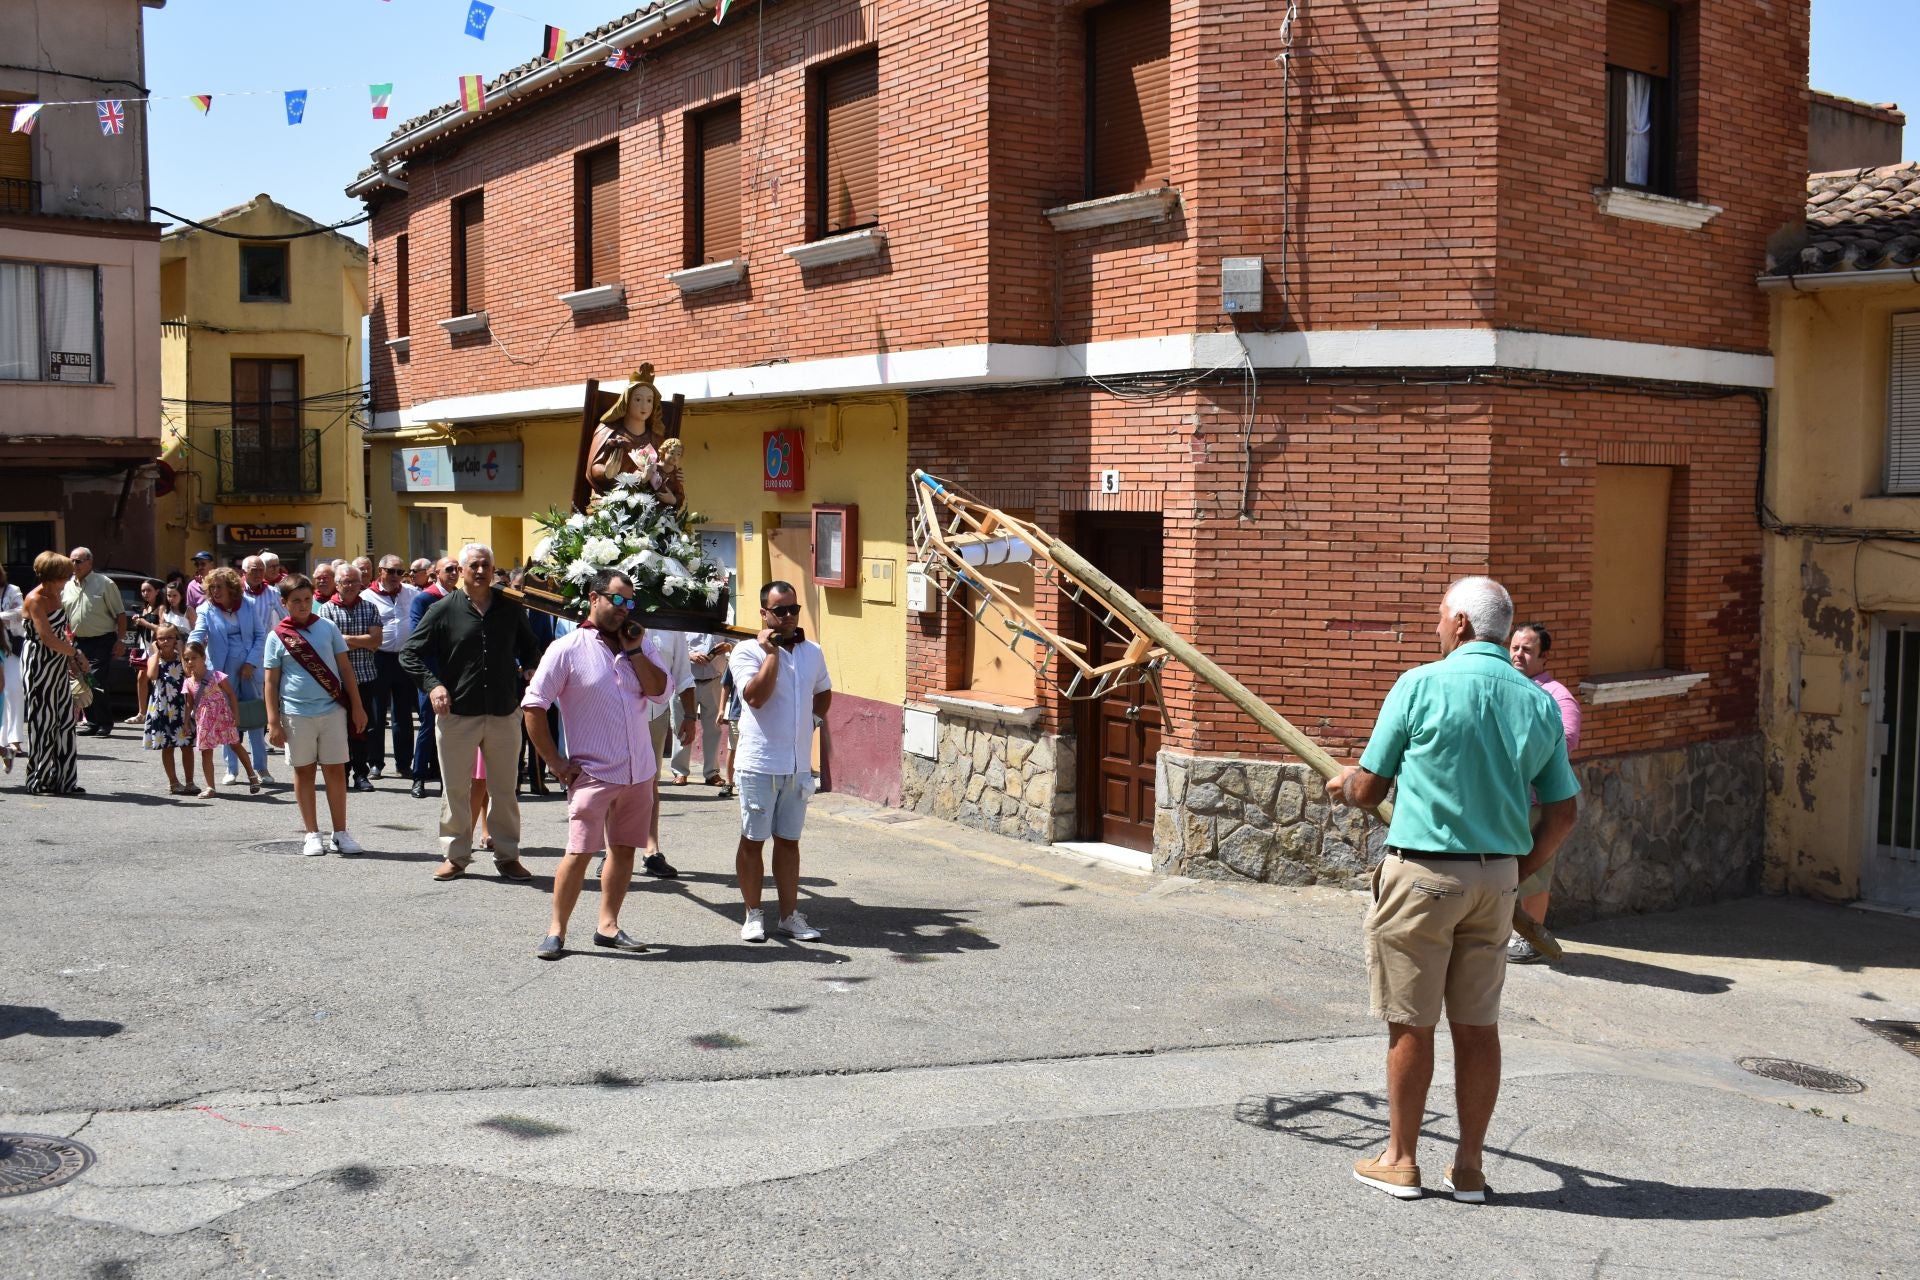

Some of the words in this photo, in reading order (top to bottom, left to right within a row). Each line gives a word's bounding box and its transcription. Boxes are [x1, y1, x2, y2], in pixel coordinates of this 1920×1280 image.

[51, 353, 62, 363] SE
[64, 354, 91, 365] VENDE
[765, 479, 778, 488] EURO
[1106, 474, 1113, 491] 5
[249, 528, 297, 536] TABACOS
